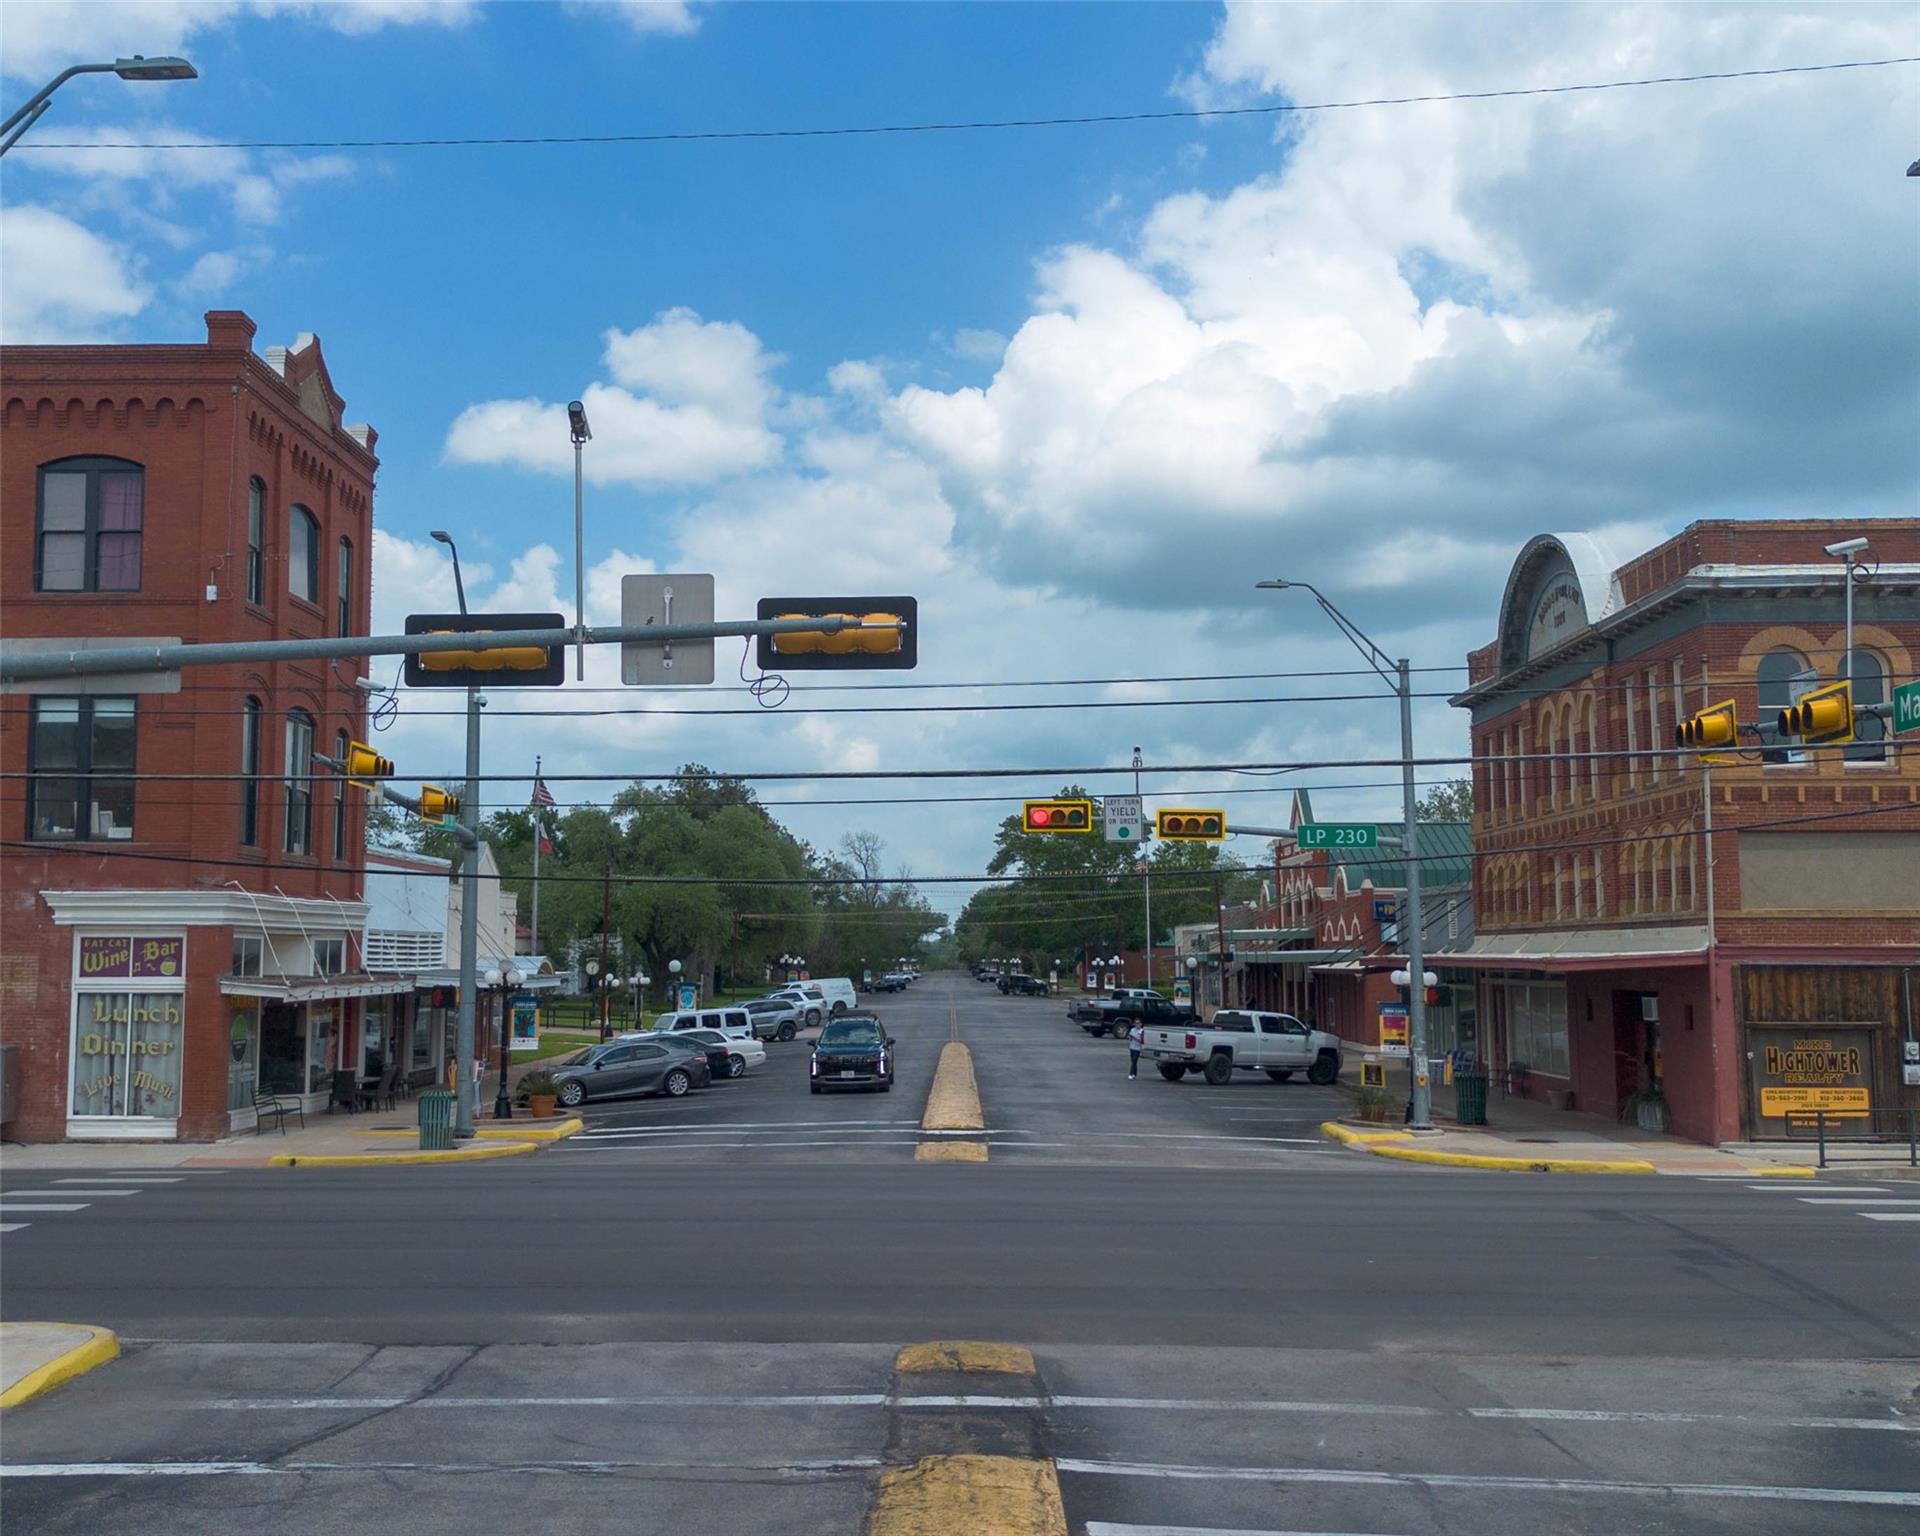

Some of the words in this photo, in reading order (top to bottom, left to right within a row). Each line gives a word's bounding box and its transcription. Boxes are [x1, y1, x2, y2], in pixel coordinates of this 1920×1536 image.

[1111, 807, 1136, 816] YIELD
[1306, 829, 1327, 844] LP
[1335, 829, 1368, 844] 230
[84, 939, 105, 948] FAT
[108, 939, 128, 948] CAT
[83, 950, 129, 973] Wine
[142, 941, 179, 962] Bar
[92, 1000, 180, 1024] Lunch
[82, 1033, 174, 1056] Dinner
[1793, 1039, 1832, 1050] MIKE
[1766, 1046, 1861, 1075] HIGHTOWER
[84, 1074, 121, 1098] Live
[134, 1071, 176, 1099] Music
[1784, 1073, 1844, 1083] REALTY
